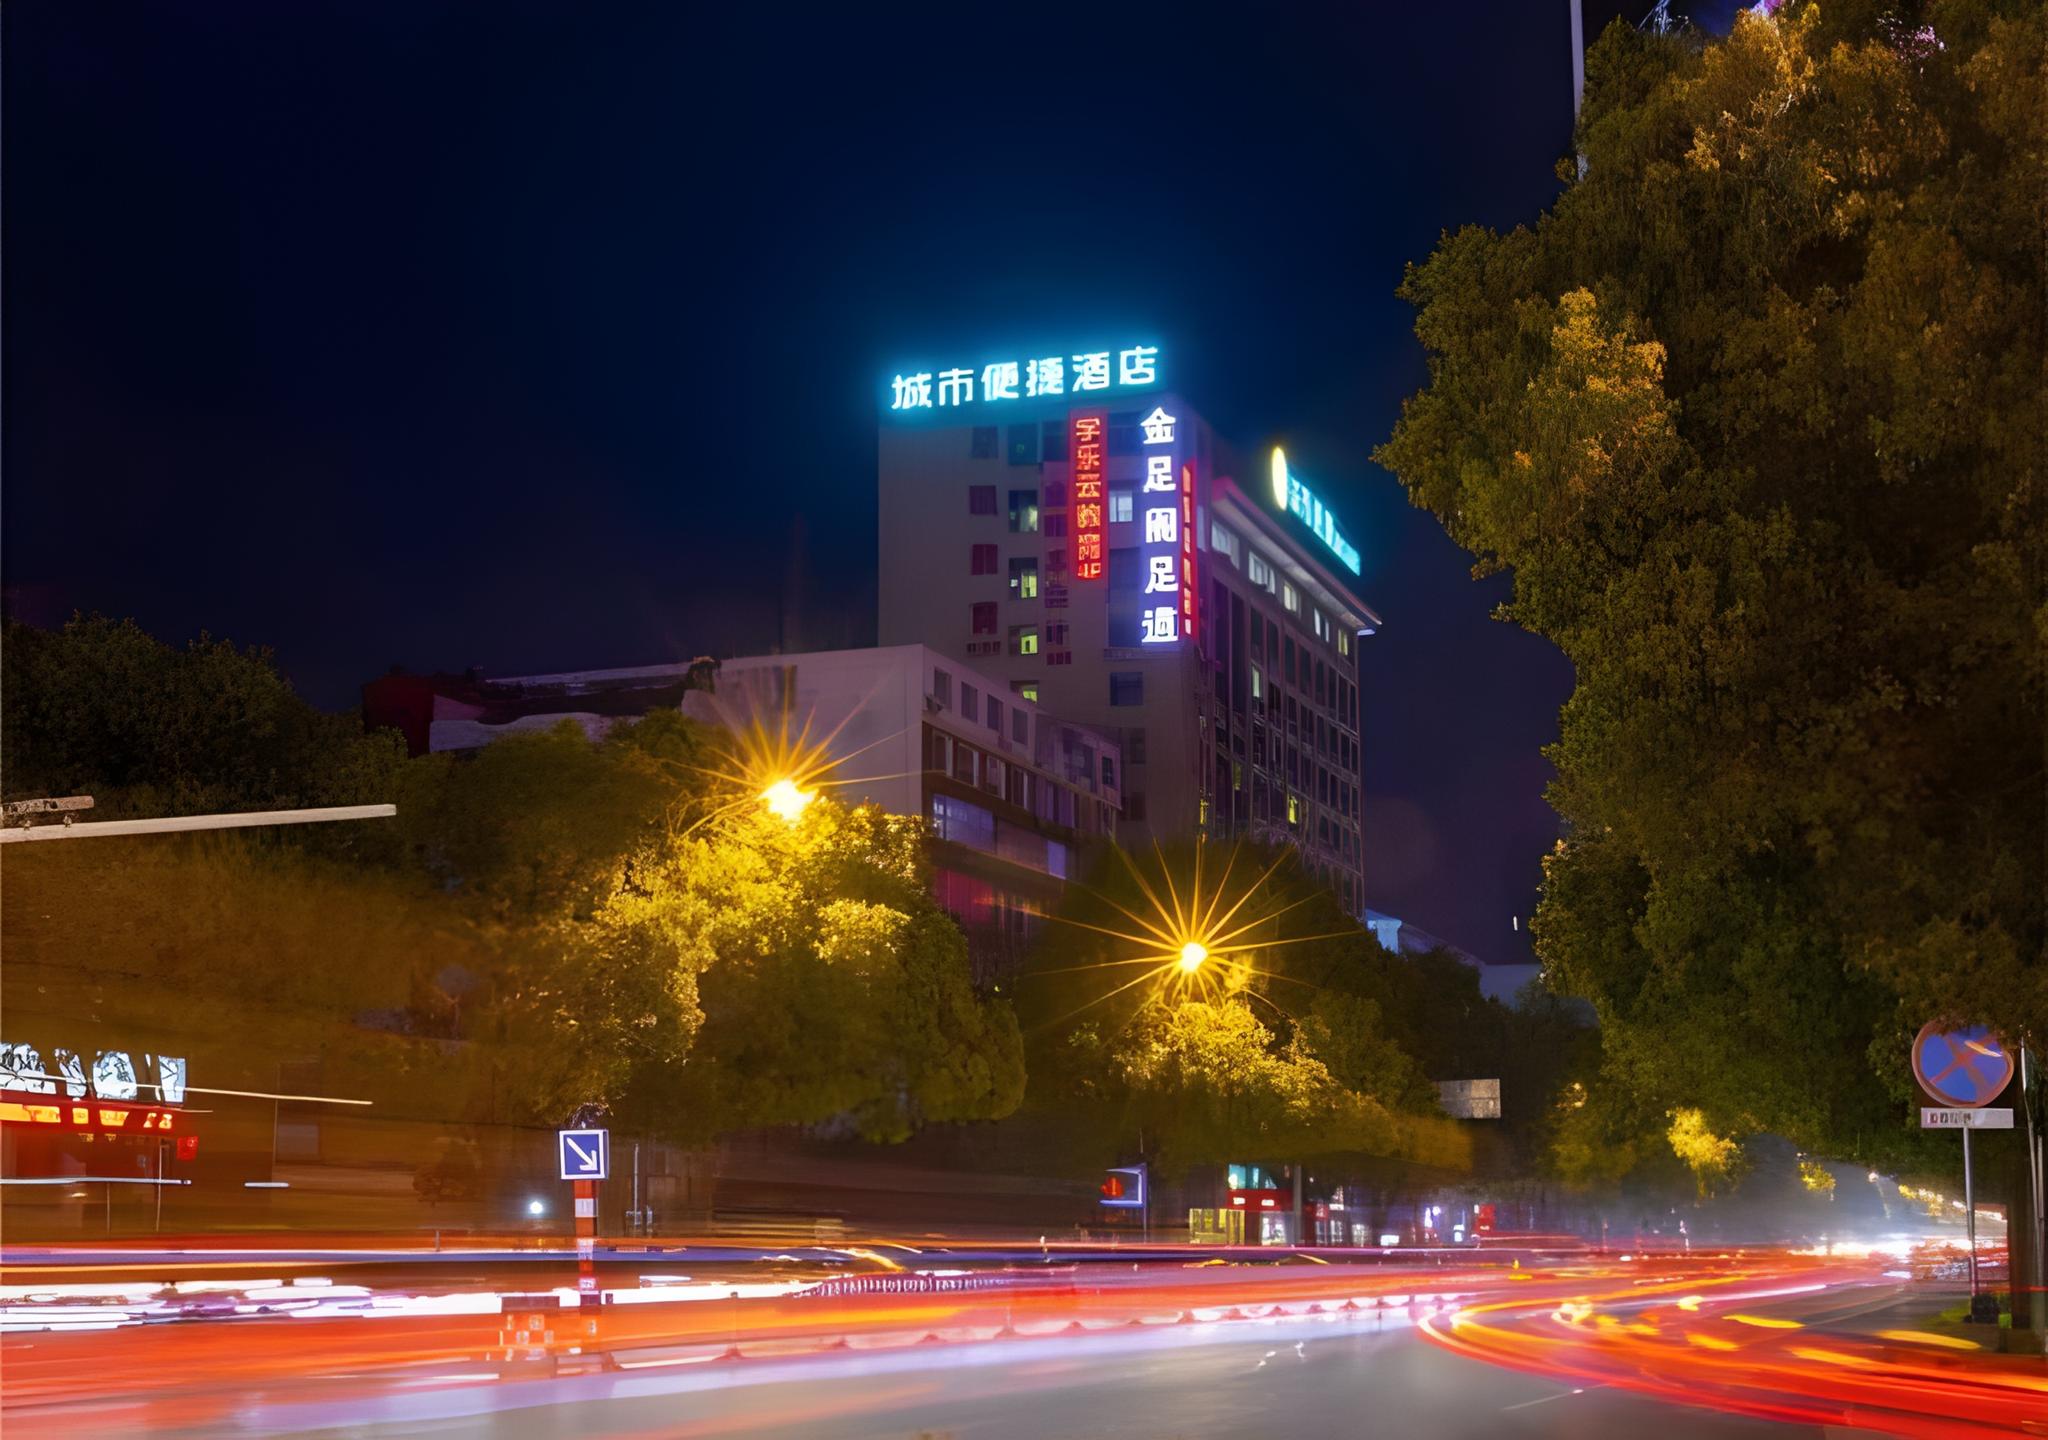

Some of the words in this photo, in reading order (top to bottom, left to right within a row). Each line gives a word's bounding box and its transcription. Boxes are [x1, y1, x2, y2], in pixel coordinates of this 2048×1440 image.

[891, 346, 1159, 410] 城市便捷酒店
